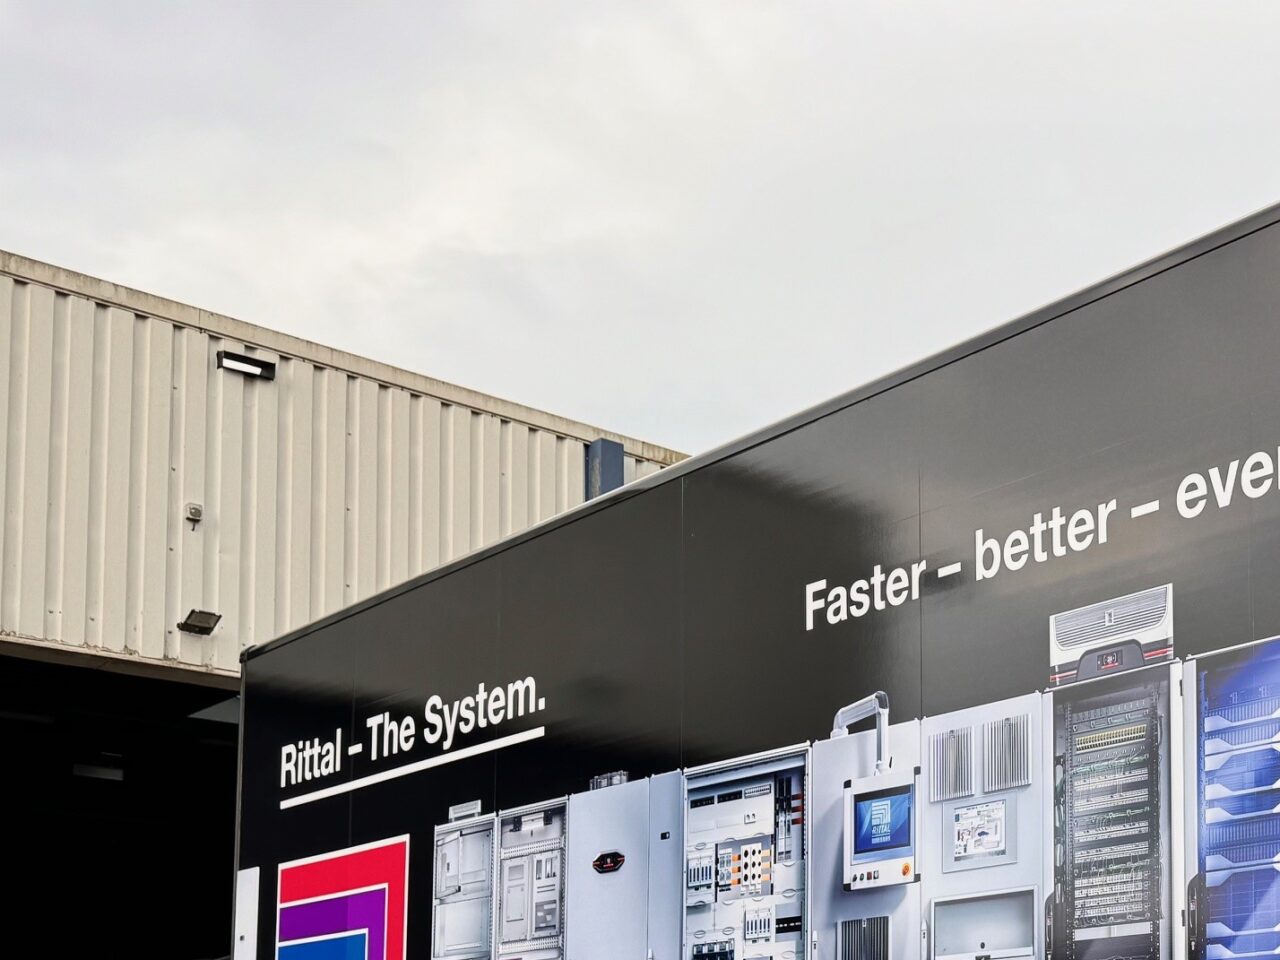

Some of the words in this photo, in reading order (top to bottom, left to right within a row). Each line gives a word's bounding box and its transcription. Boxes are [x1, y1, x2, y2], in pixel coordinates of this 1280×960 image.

[805, 556, 926, 631] Faster
[974, 498, 1117, 582] better
[280, 728, 341, 788] Rittal
[366, 711, 416, 760] The
[424, 676, 546, 750] System.
